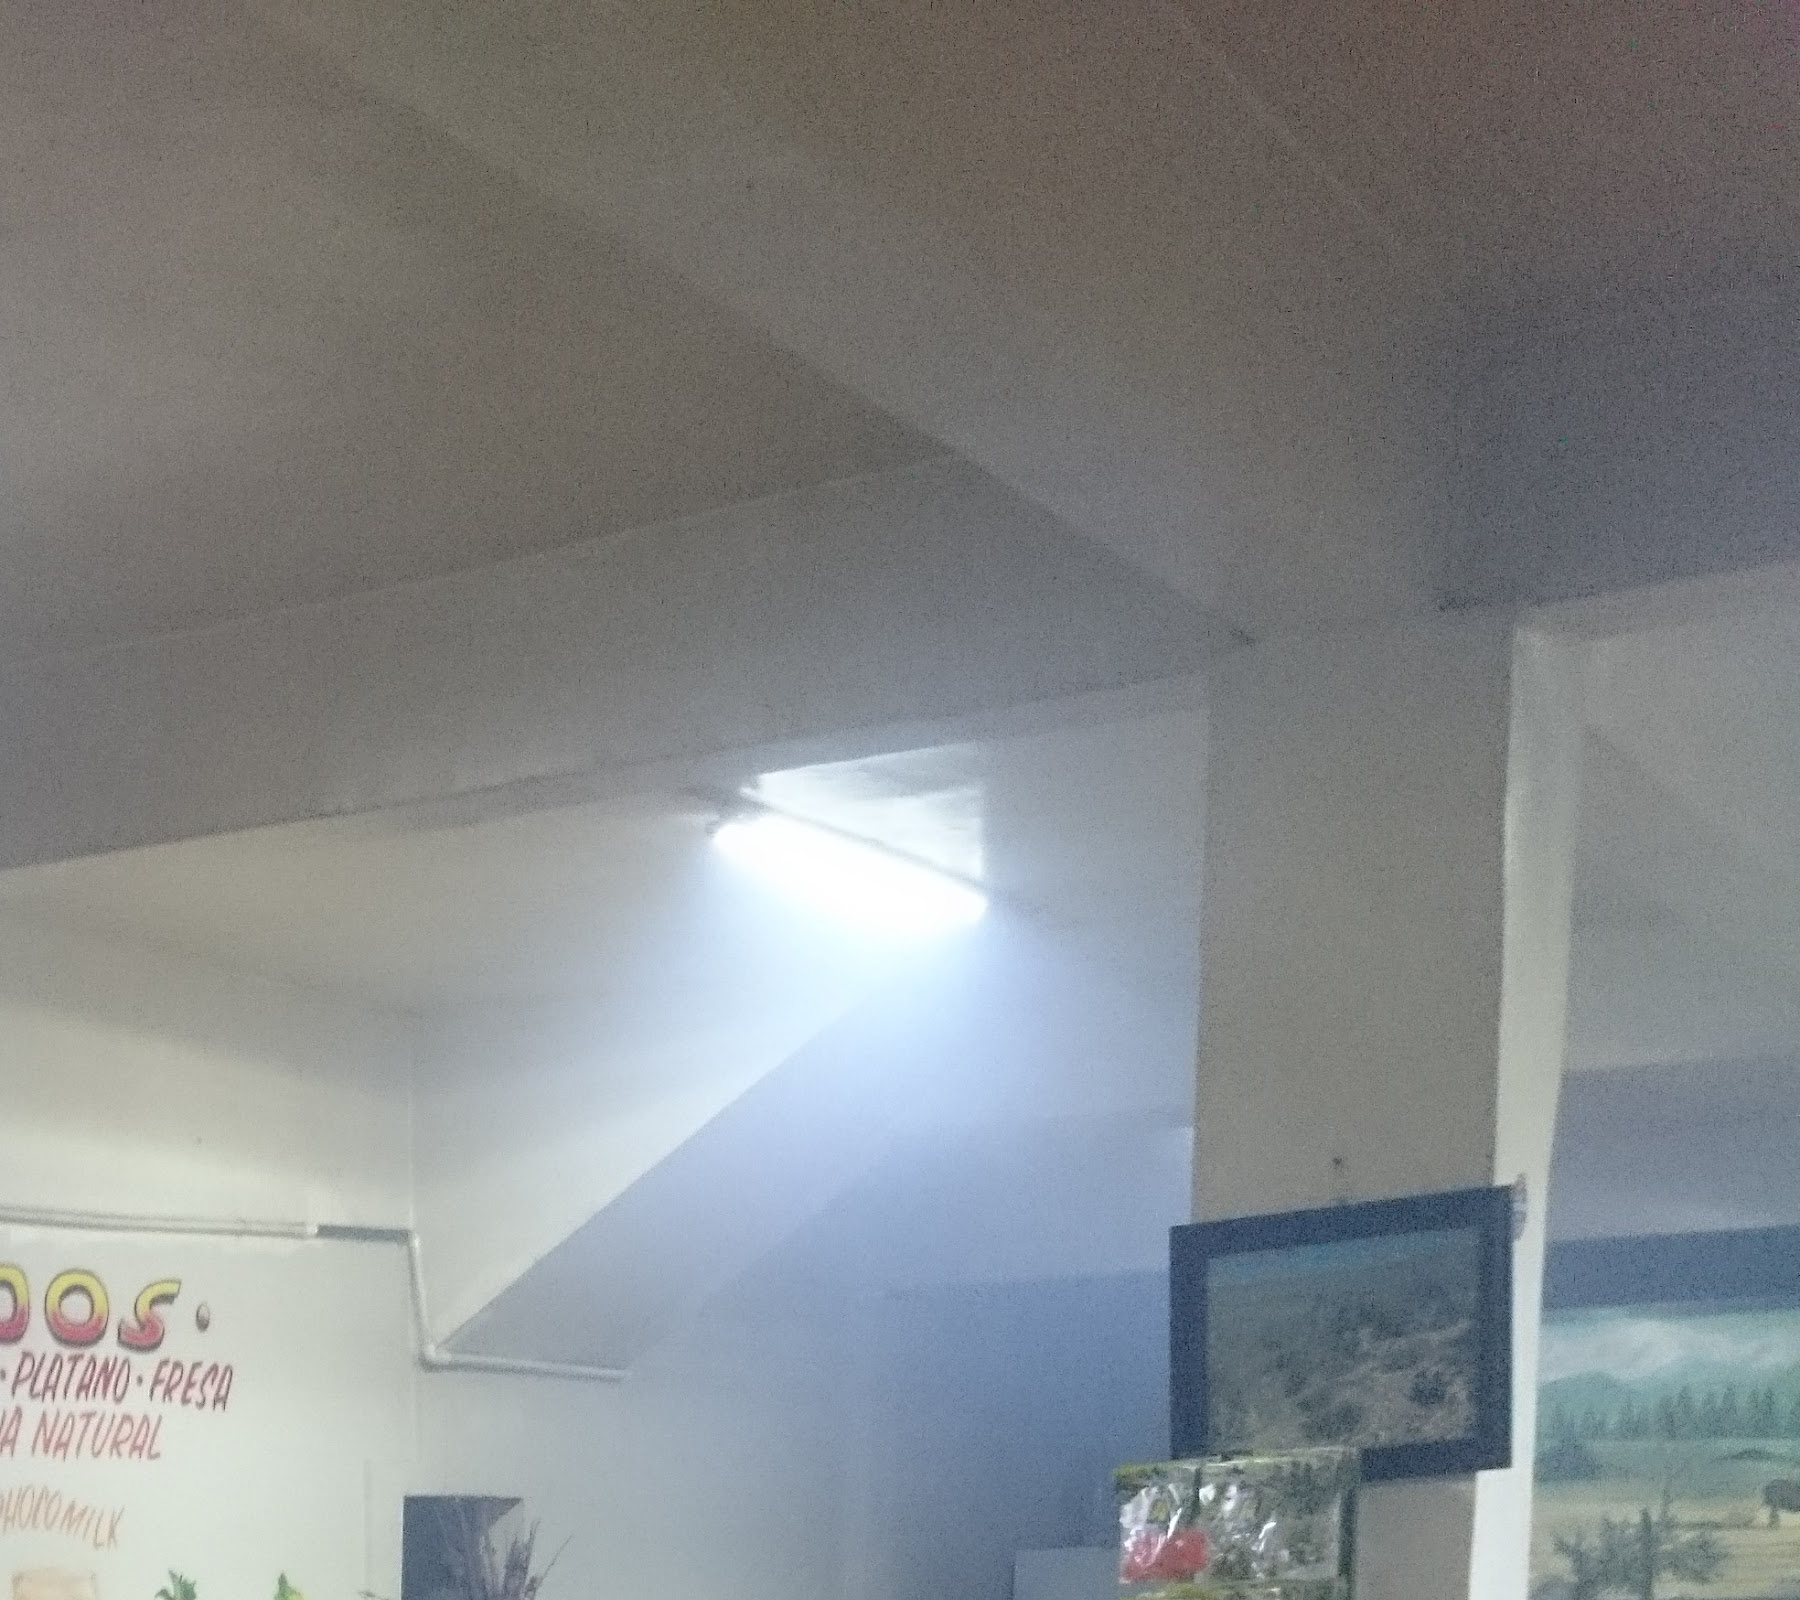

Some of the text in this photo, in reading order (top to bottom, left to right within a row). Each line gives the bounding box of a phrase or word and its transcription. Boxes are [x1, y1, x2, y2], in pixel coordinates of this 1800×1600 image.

[10, 1350, 132, 1406] PLATANO
[149, 1356, 235, 1413] FRESA
[31, 1408, 164, 1462] NATURAL
